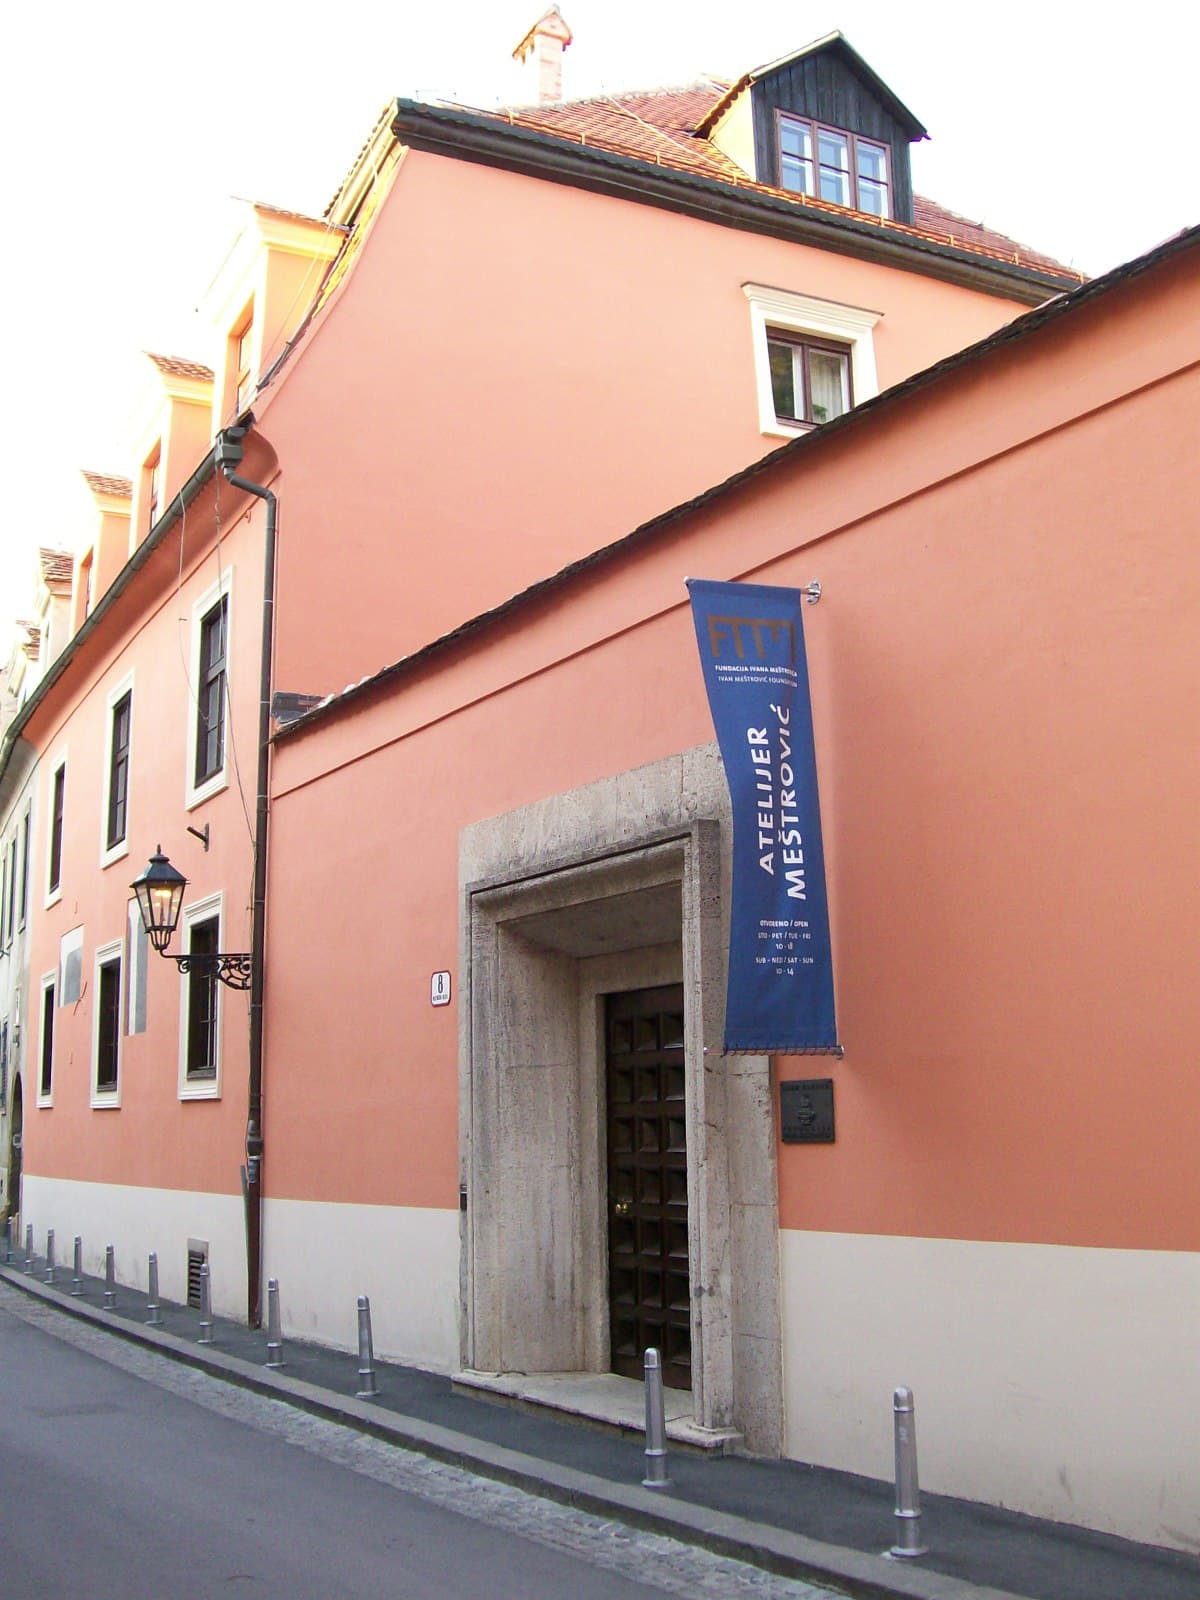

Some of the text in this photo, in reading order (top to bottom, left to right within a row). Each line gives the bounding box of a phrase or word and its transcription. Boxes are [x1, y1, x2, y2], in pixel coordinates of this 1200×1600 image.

[747, 727, 775, 876] ATELIJER
[770, 703, 807, 900] MEŠTROVIĆ
[437, 974, 443, 994] 8
